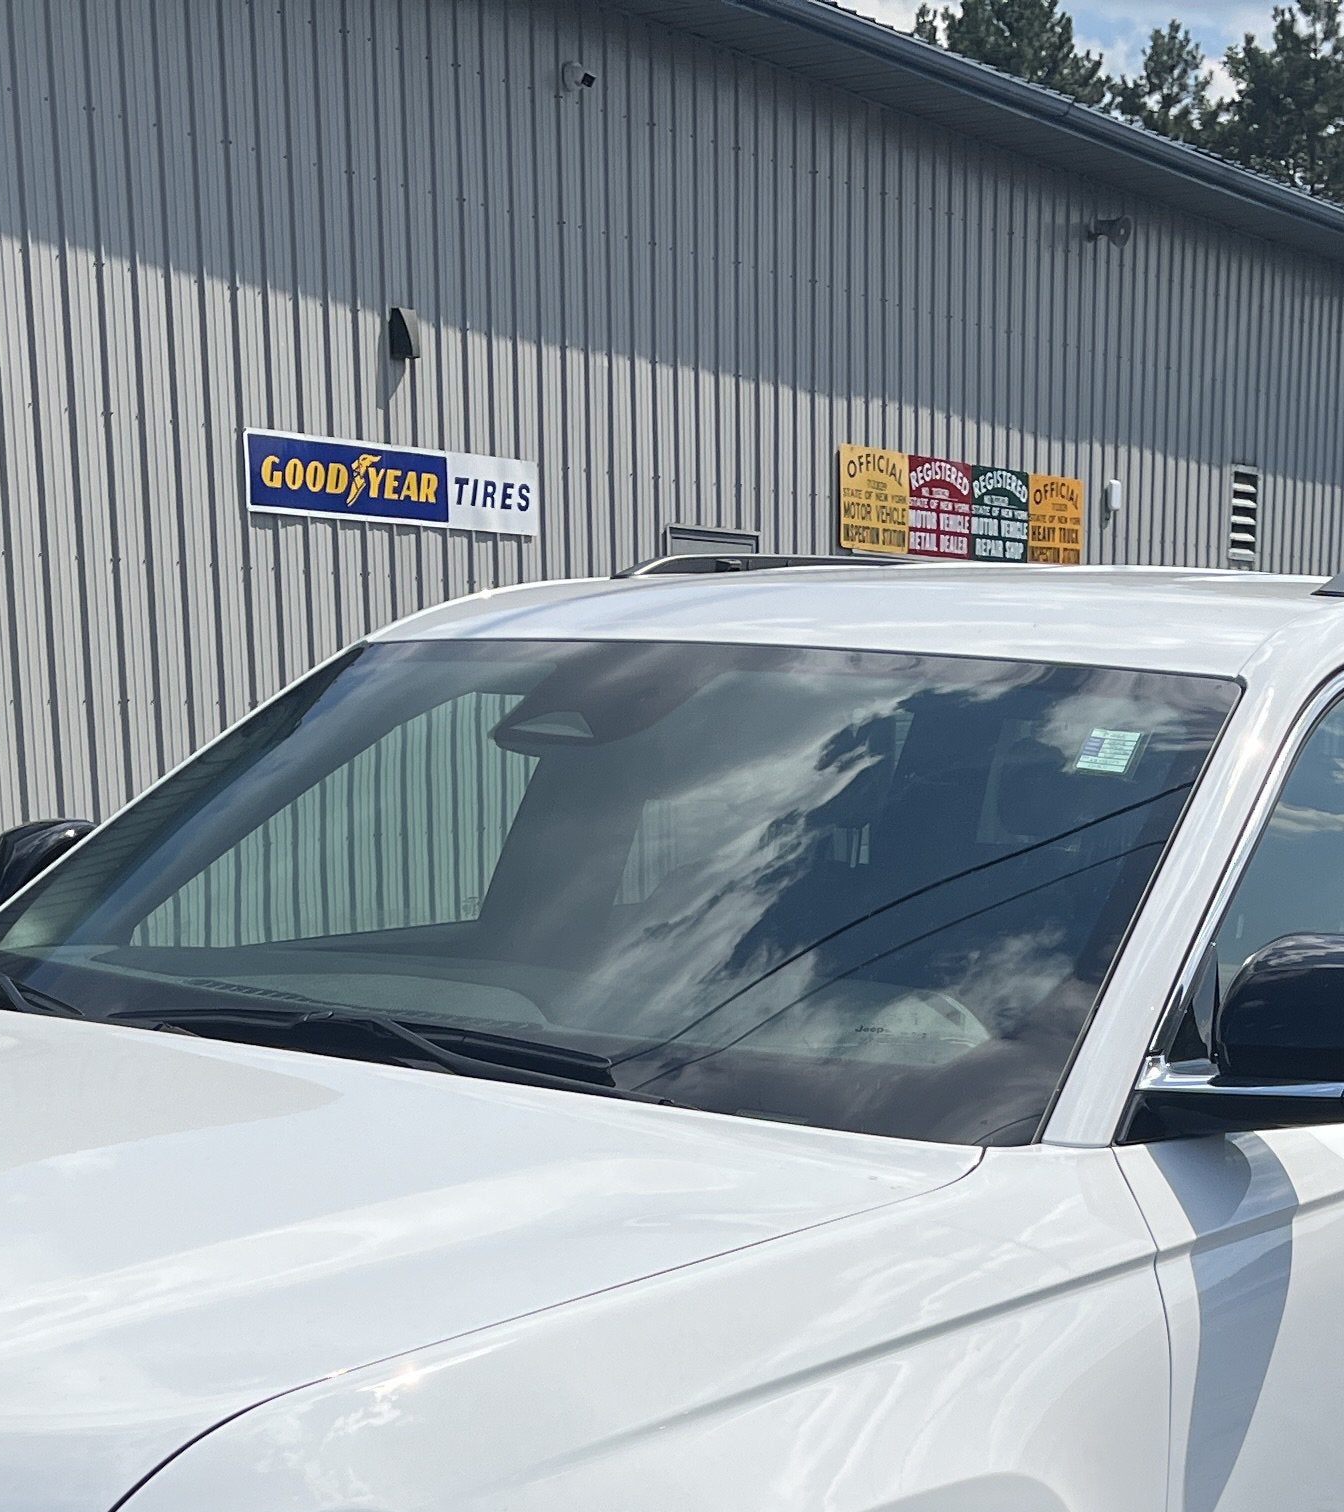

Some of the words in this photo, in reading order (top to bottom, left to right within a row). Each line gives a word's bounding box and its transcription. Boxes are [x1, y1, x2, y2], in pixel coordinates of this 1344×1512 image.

[847, 453, 902, 487] OFFICIAL
[910, 461, 969, 496] REGISTERED
[261, 454, 439, 505] GOODYEAR
[454, 477, 531, 512] TIRES
[865, 490, 873, 499] OF
[973, 470, 1028, 503] REGISTERED
[929, 499, 939, 509] OF
[1034, 482, 1079, 510] OFFICIAL
[843, 501, 872, 521] MOTOR
[876, 505, 906, 526] VEHICLE
[992, 507, 1000, 517] OF
[1031, 525, 1056, 542] HEAVY
[855, 1025, 884, 1034] Jeep
